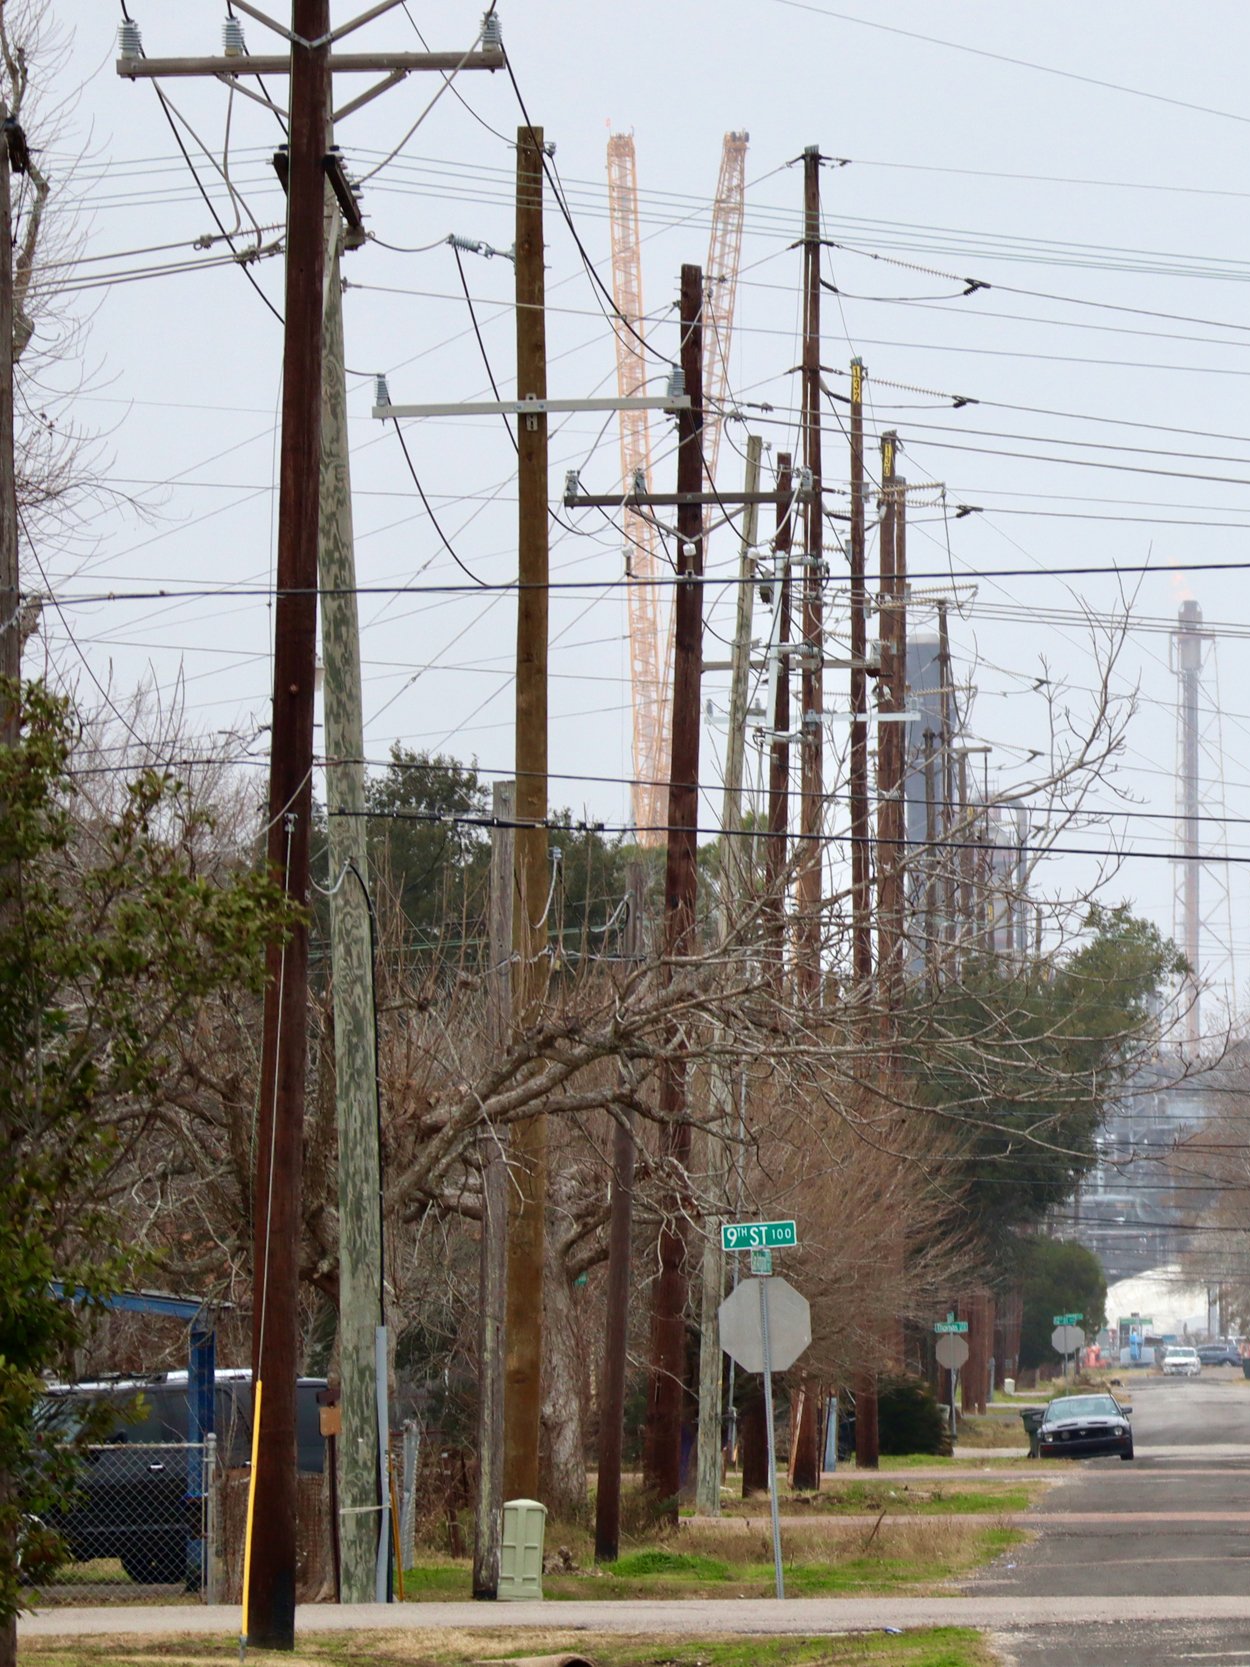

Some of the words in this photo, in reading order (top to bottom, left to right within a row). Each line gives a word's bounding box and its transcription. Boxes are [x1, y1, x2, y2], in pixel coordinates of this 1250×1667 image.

[727, 1227, 748, 1247] 9TH
[749, 1226, 768, 1246] ST
[772, 1228, 792, 1240] 100
